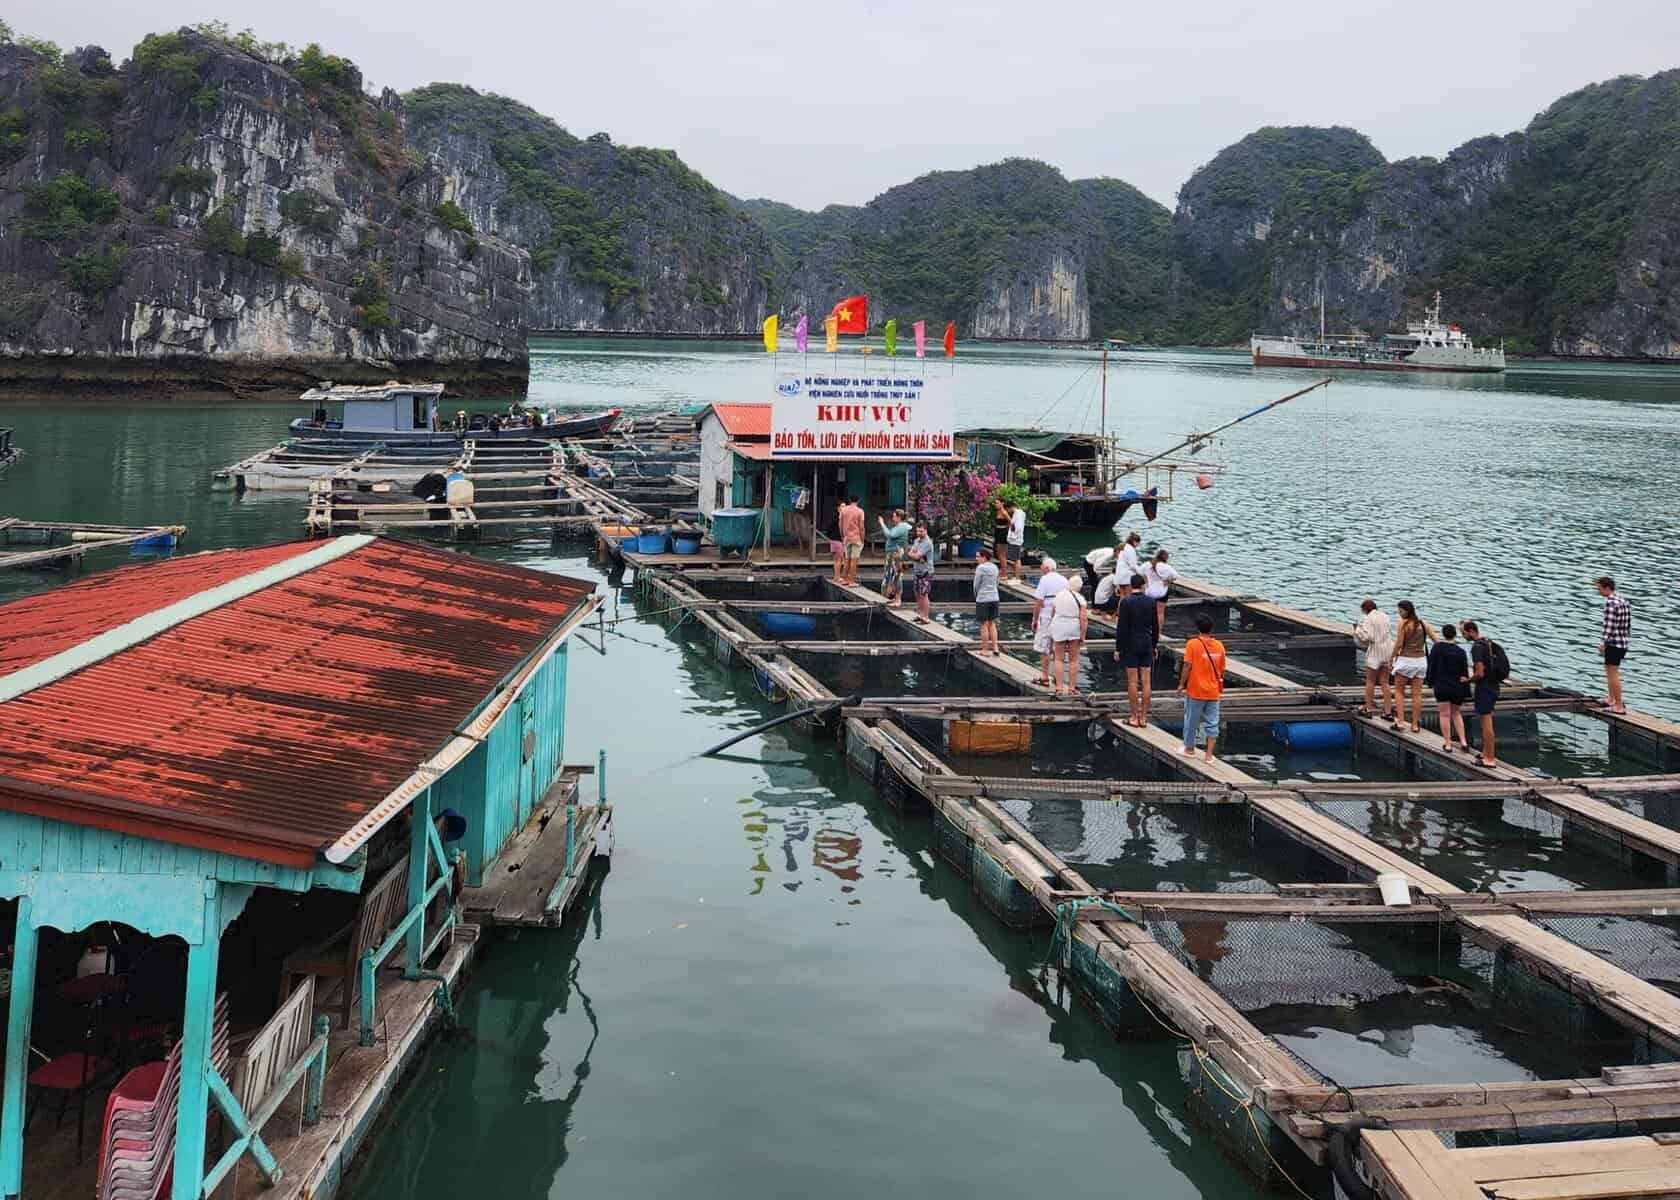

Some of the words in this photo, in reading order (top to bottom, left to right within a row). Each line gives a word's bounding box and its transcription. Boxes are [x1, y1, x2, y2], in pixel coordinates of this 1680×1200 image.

[817, 405, 866, 421] KHU
[872, 402, 912, 427] VỰC
[775, 428, 793, 448] BẢO
[820, 432, 837, 448] LƯU
[841, 431, 856, 448] GIỮ
[859, 430, 890, 449] NGUỒN
[894, 434, 911, 449] GEN
[914, 429, 929, 449] HẢI
[932, 429, 950, 449] SẢN
